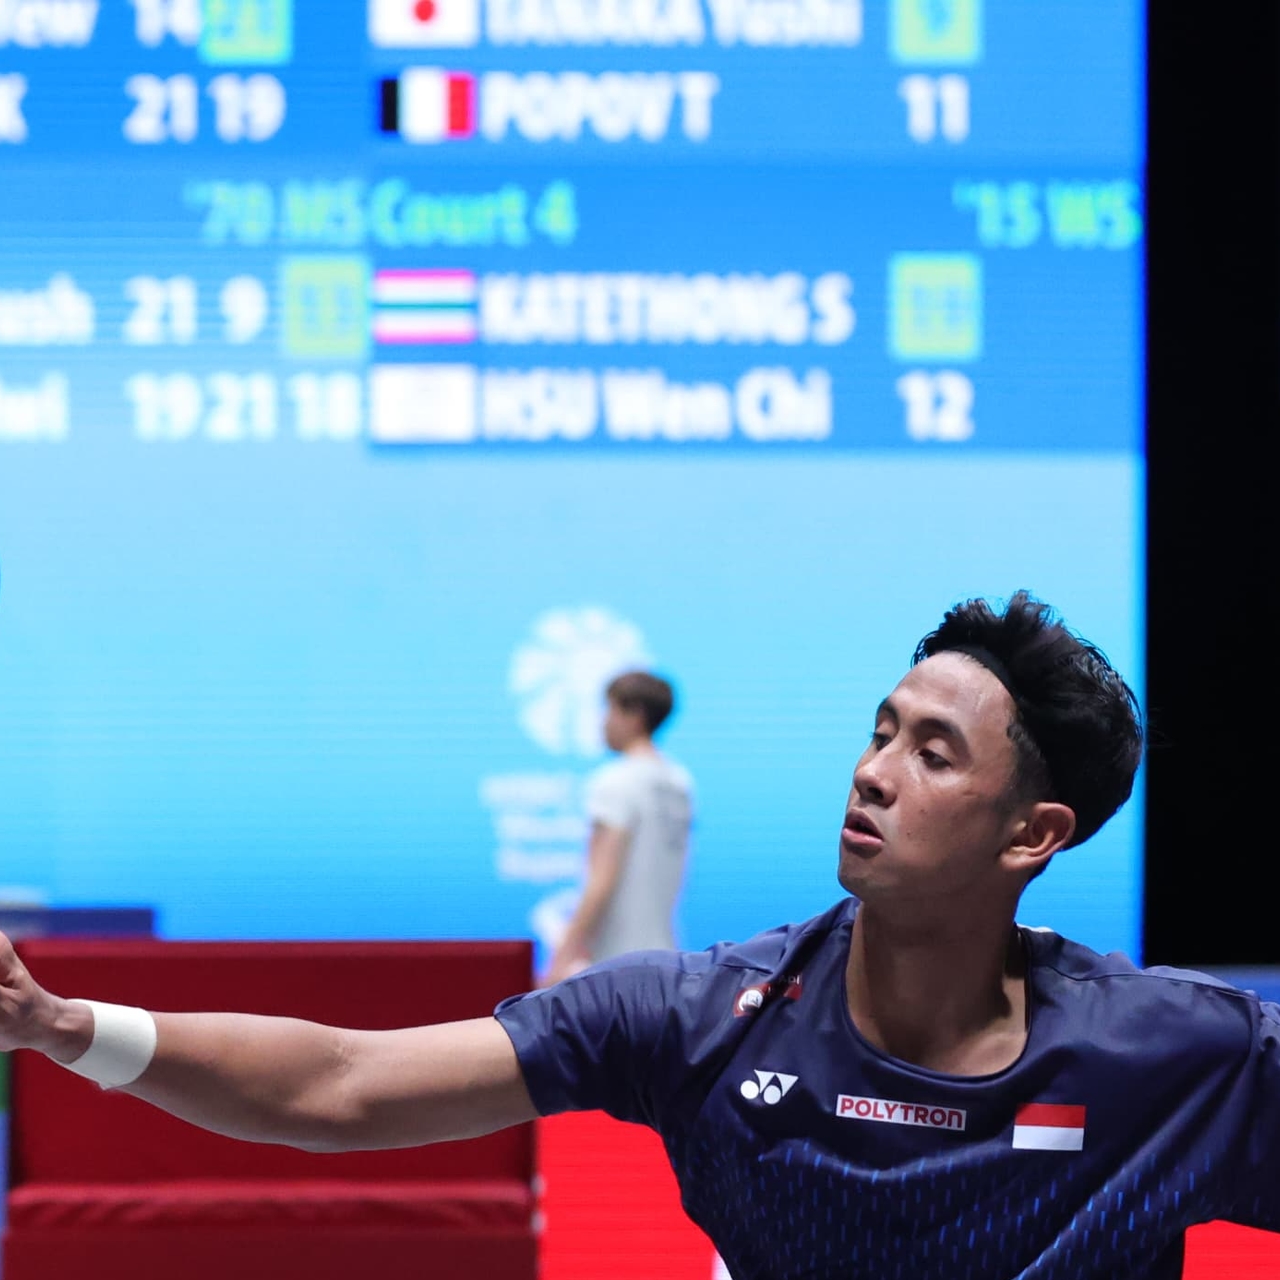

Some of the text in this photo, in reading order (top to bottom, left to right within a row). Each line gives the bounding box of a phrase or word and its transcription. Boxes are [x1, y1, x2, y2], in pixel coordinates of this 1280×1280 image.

[123, 73, 198, 144] 21
[206, 73, 285, 144] 19
[479, 72, 969, 143] POPOV T 11
[372, 178, 528, 246] Court
[536, 179, 578, 246] 4
[123, 276, 198, 346] 21
[219, 276, 267, 346] 9
[479, 271, 807, 345] KATETHONG
[810, 271, 856, 345] S
[126, 373, 201, 443] 19
[204, 373, 277, 443] 21
[479, 368, 975, 441] HSU Wen Chi 12
[840, 1098, 963, 1128] POLYTRON
